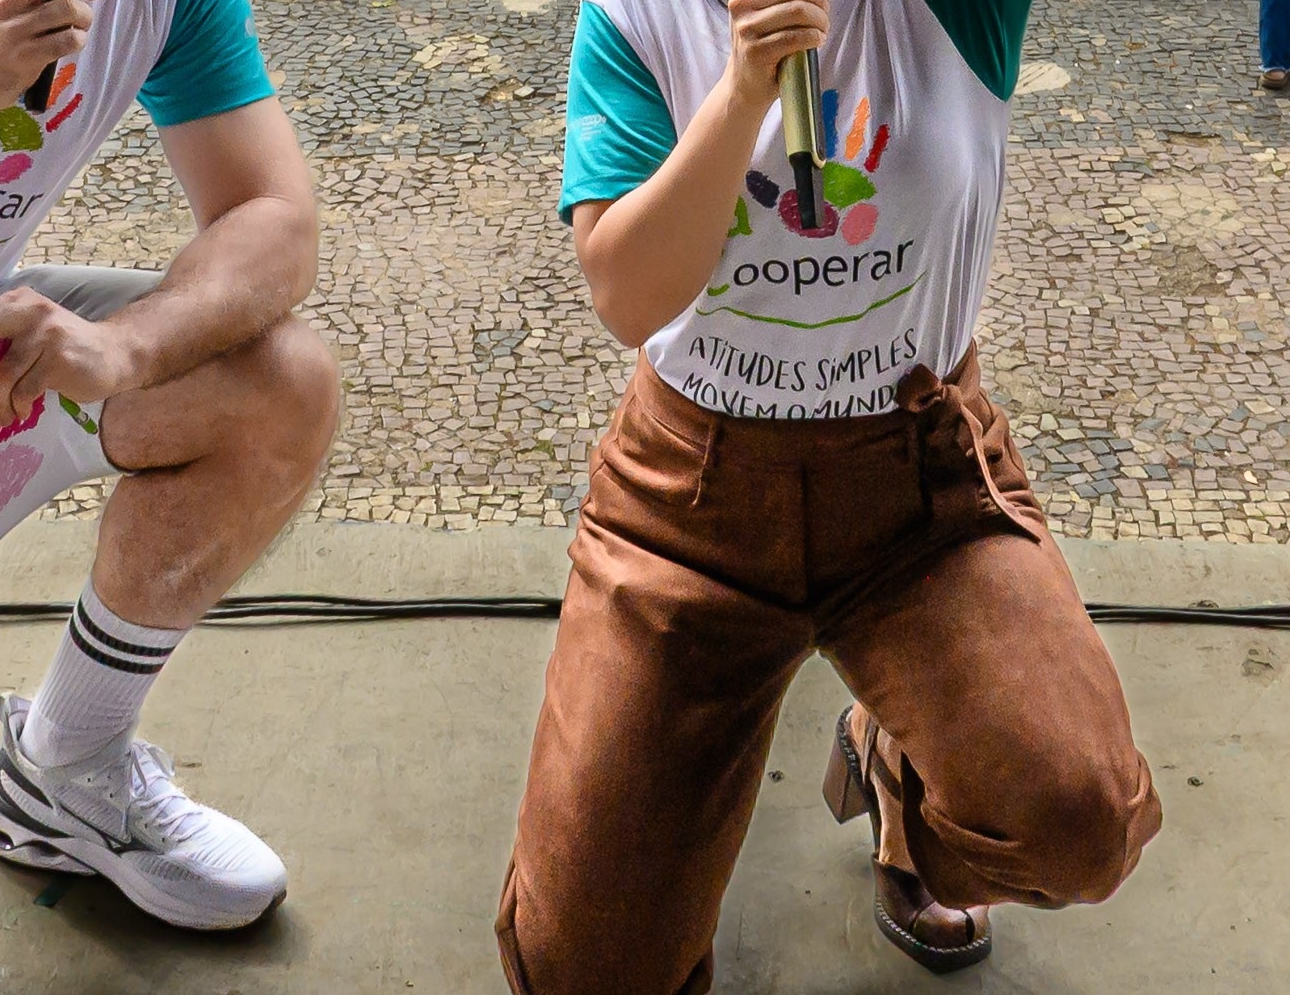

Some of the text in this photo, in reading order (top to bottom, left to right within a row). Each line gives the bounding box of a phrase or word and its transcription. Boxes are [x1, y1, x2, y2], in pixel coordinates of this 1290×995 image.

[707, 239, 915, 297] ooperar
[682, 371, 778, 418] MOVEM
[808, 384, 898, 418] MUND
